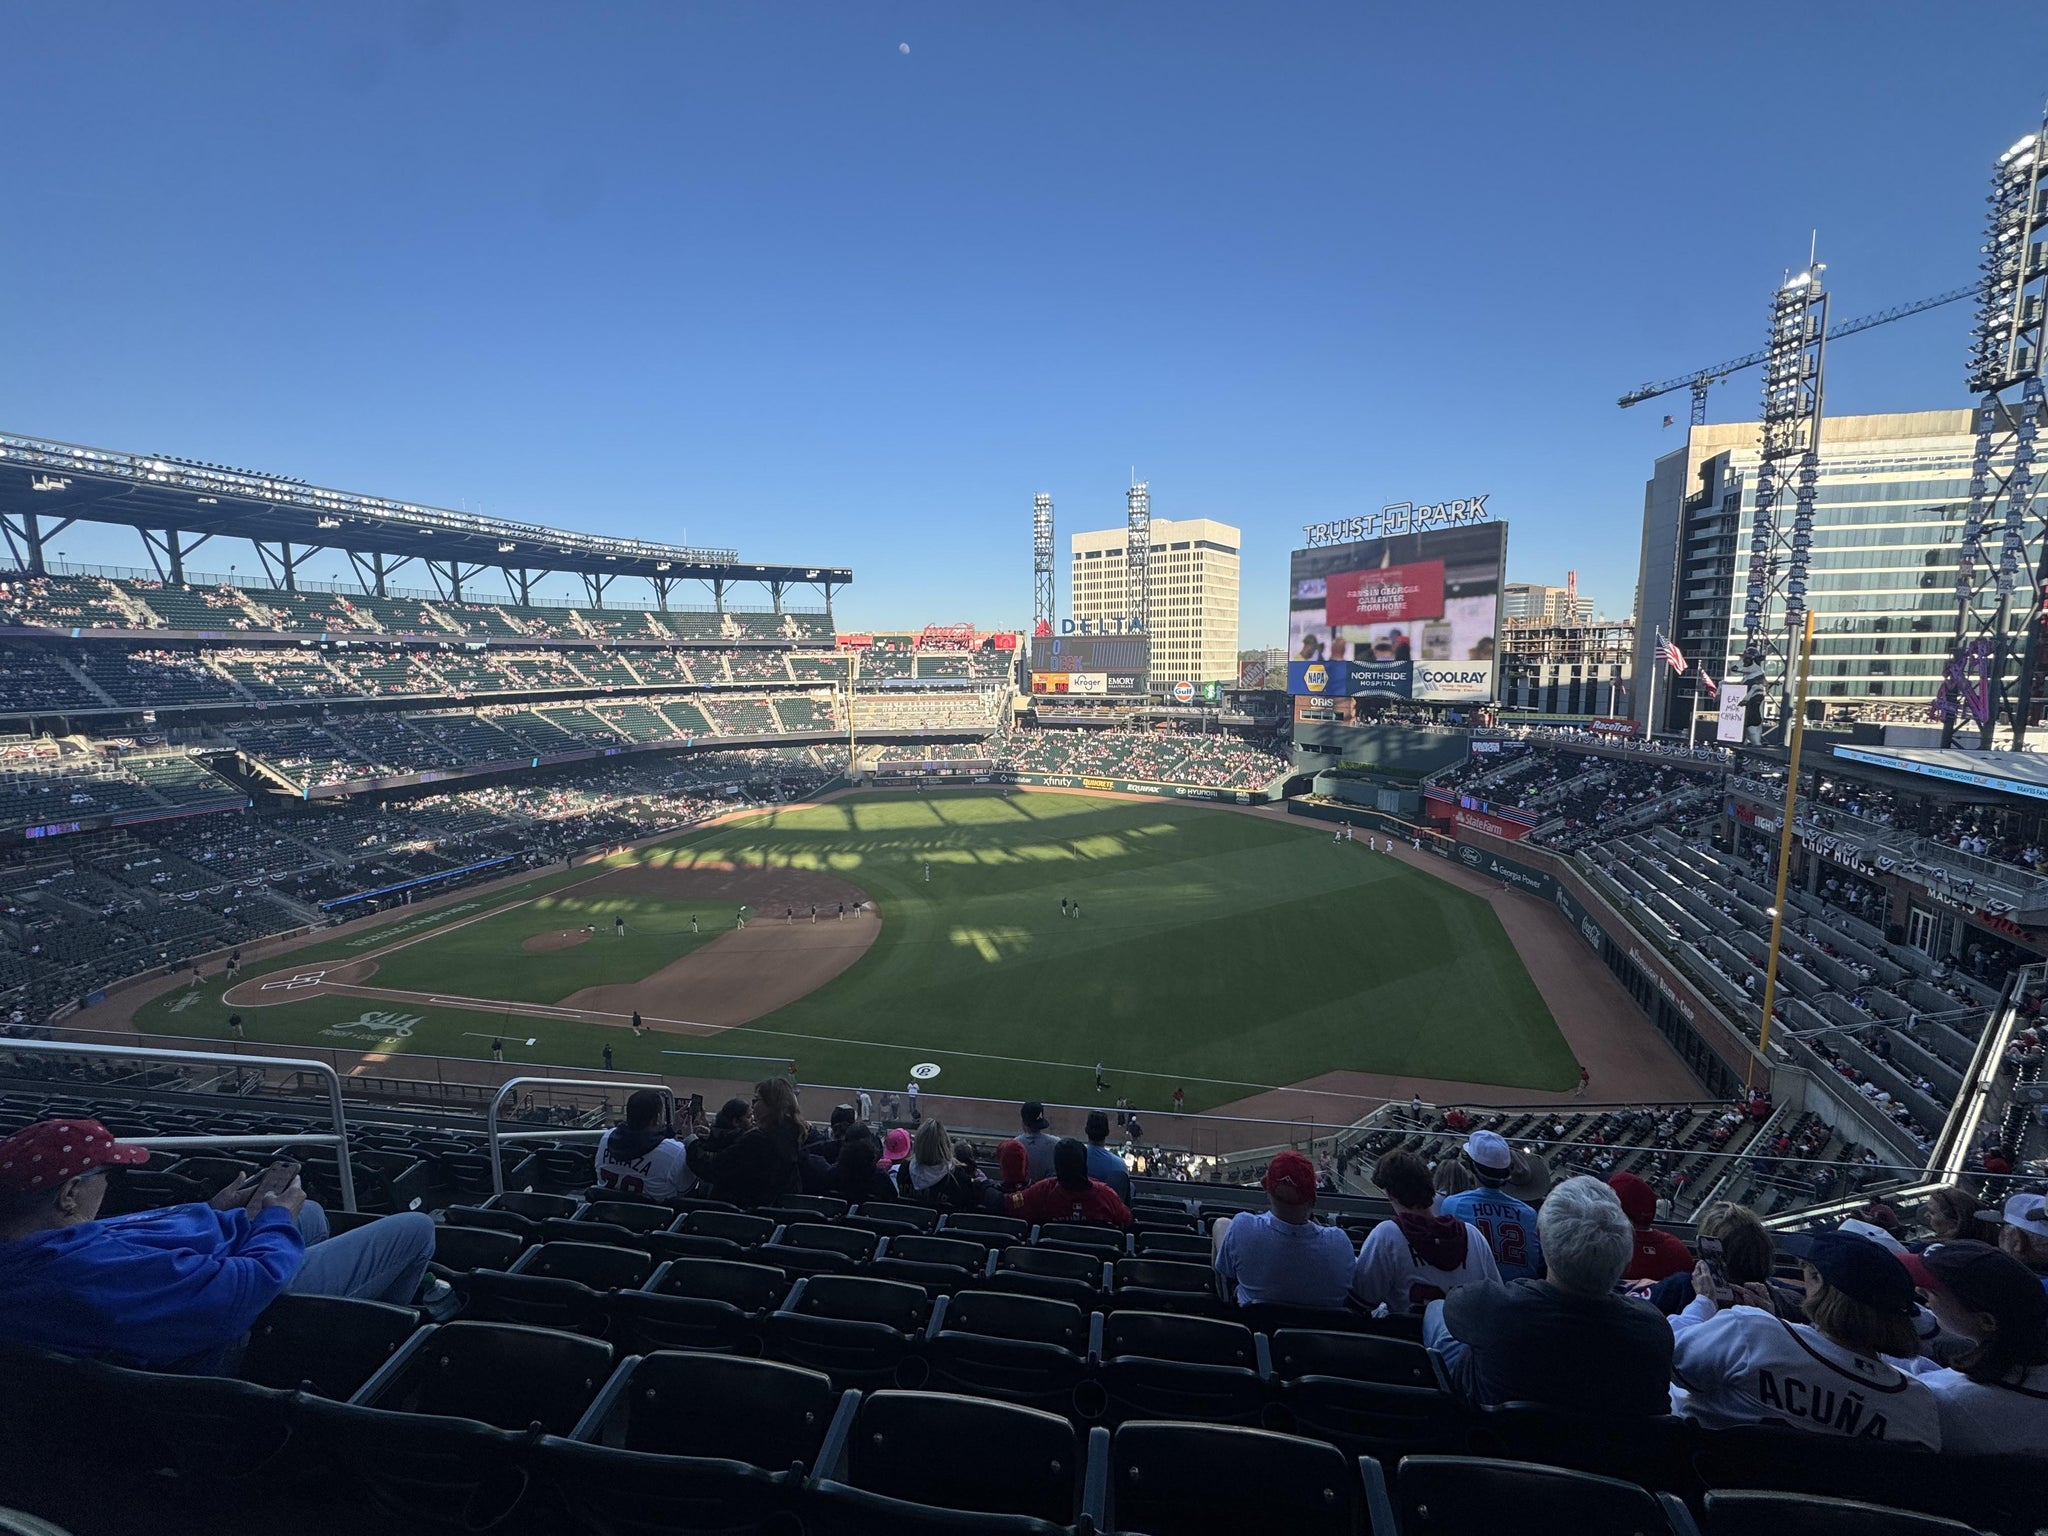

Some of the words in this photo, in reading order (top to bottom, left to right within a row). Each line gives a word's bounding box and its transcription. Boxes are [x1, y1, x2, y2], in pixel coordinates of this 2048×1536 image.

[1303, 514, 1377, 544] TRUIST
[1417, 494, 1490, 527] PARK
[1370, 588, 1379, 597] IN
[1377, 595, 1404, 603] ENTER
[1356, 603, 1380, 612] FROM
[1381, 601, 1407, 611] HOME
[1061, 616, 1144, 634] DELTA
[1050, 656, 1083, 671] DECK
[1074, 674, 1101, 691] Kroger
[1108, 677, 1135, 685] EMORY
[1308, 672, 1325, 684] NAPA
[1351, 672, 1407, 681] NORTHSIDE
[1423, 671, 1487, 684] COOLRAY
[1174, 687, 1193, 695] Gulf
[1310, 697, 1334, 707] ORIS
[1727, 695, 1740, 703] EAT
[1592, 720, 1633, 733] RaceTrac
[1043, 775, 1073, 787] xfinity
[1082, 779, 1114, 788] QUIKRETE
[1126, 783, 1161, 793] EQUIFAX
[1187, 788, 1218, 797] HYUNDAI
[2016, 785, 2036, 795] BRAVES
[1463, 849, 1479, 863] Ford
[1499, 865, 1522, 882] Georgia
[1522, 873, 1542, 889] Power
[1926, 887, 1958, 908] MADE
[1471, 1203, 1521, 1221] HOVEY
[1475, 1218, 1528, 1267] 12
[1758, 1368, 1888, 1441] ACUÑA
